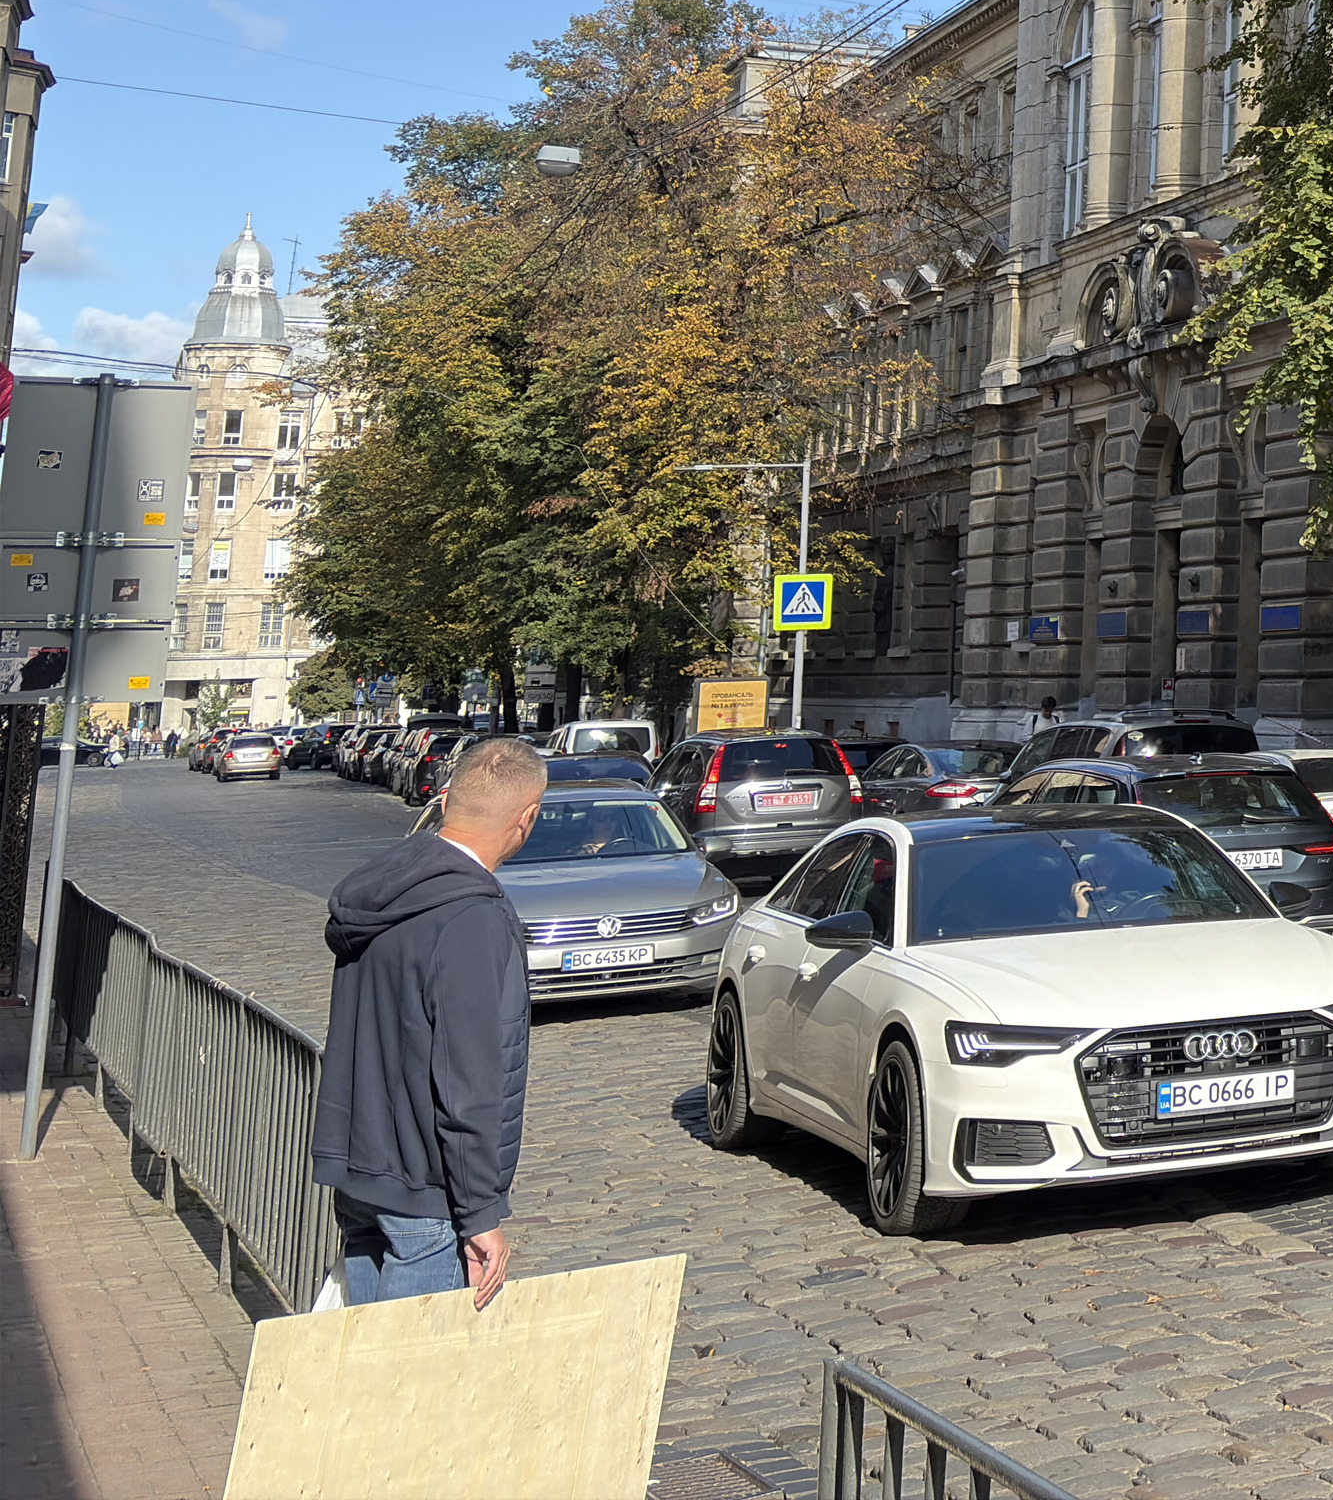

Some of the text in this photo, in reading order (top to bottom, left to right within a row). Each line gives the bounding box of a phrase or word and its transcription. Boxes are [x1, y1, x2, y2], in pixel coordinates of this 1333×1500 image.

[787, 794, 809, 804] 2851
[1235, 851, 1280, 866] 6370 TA
[573, 953, 592, 967] BC
[595, 949, 626, 965] 6435
[628, 948, 648, 962] KP
[1160, 1074, 1289, 1109] UA BC 0666 IP
